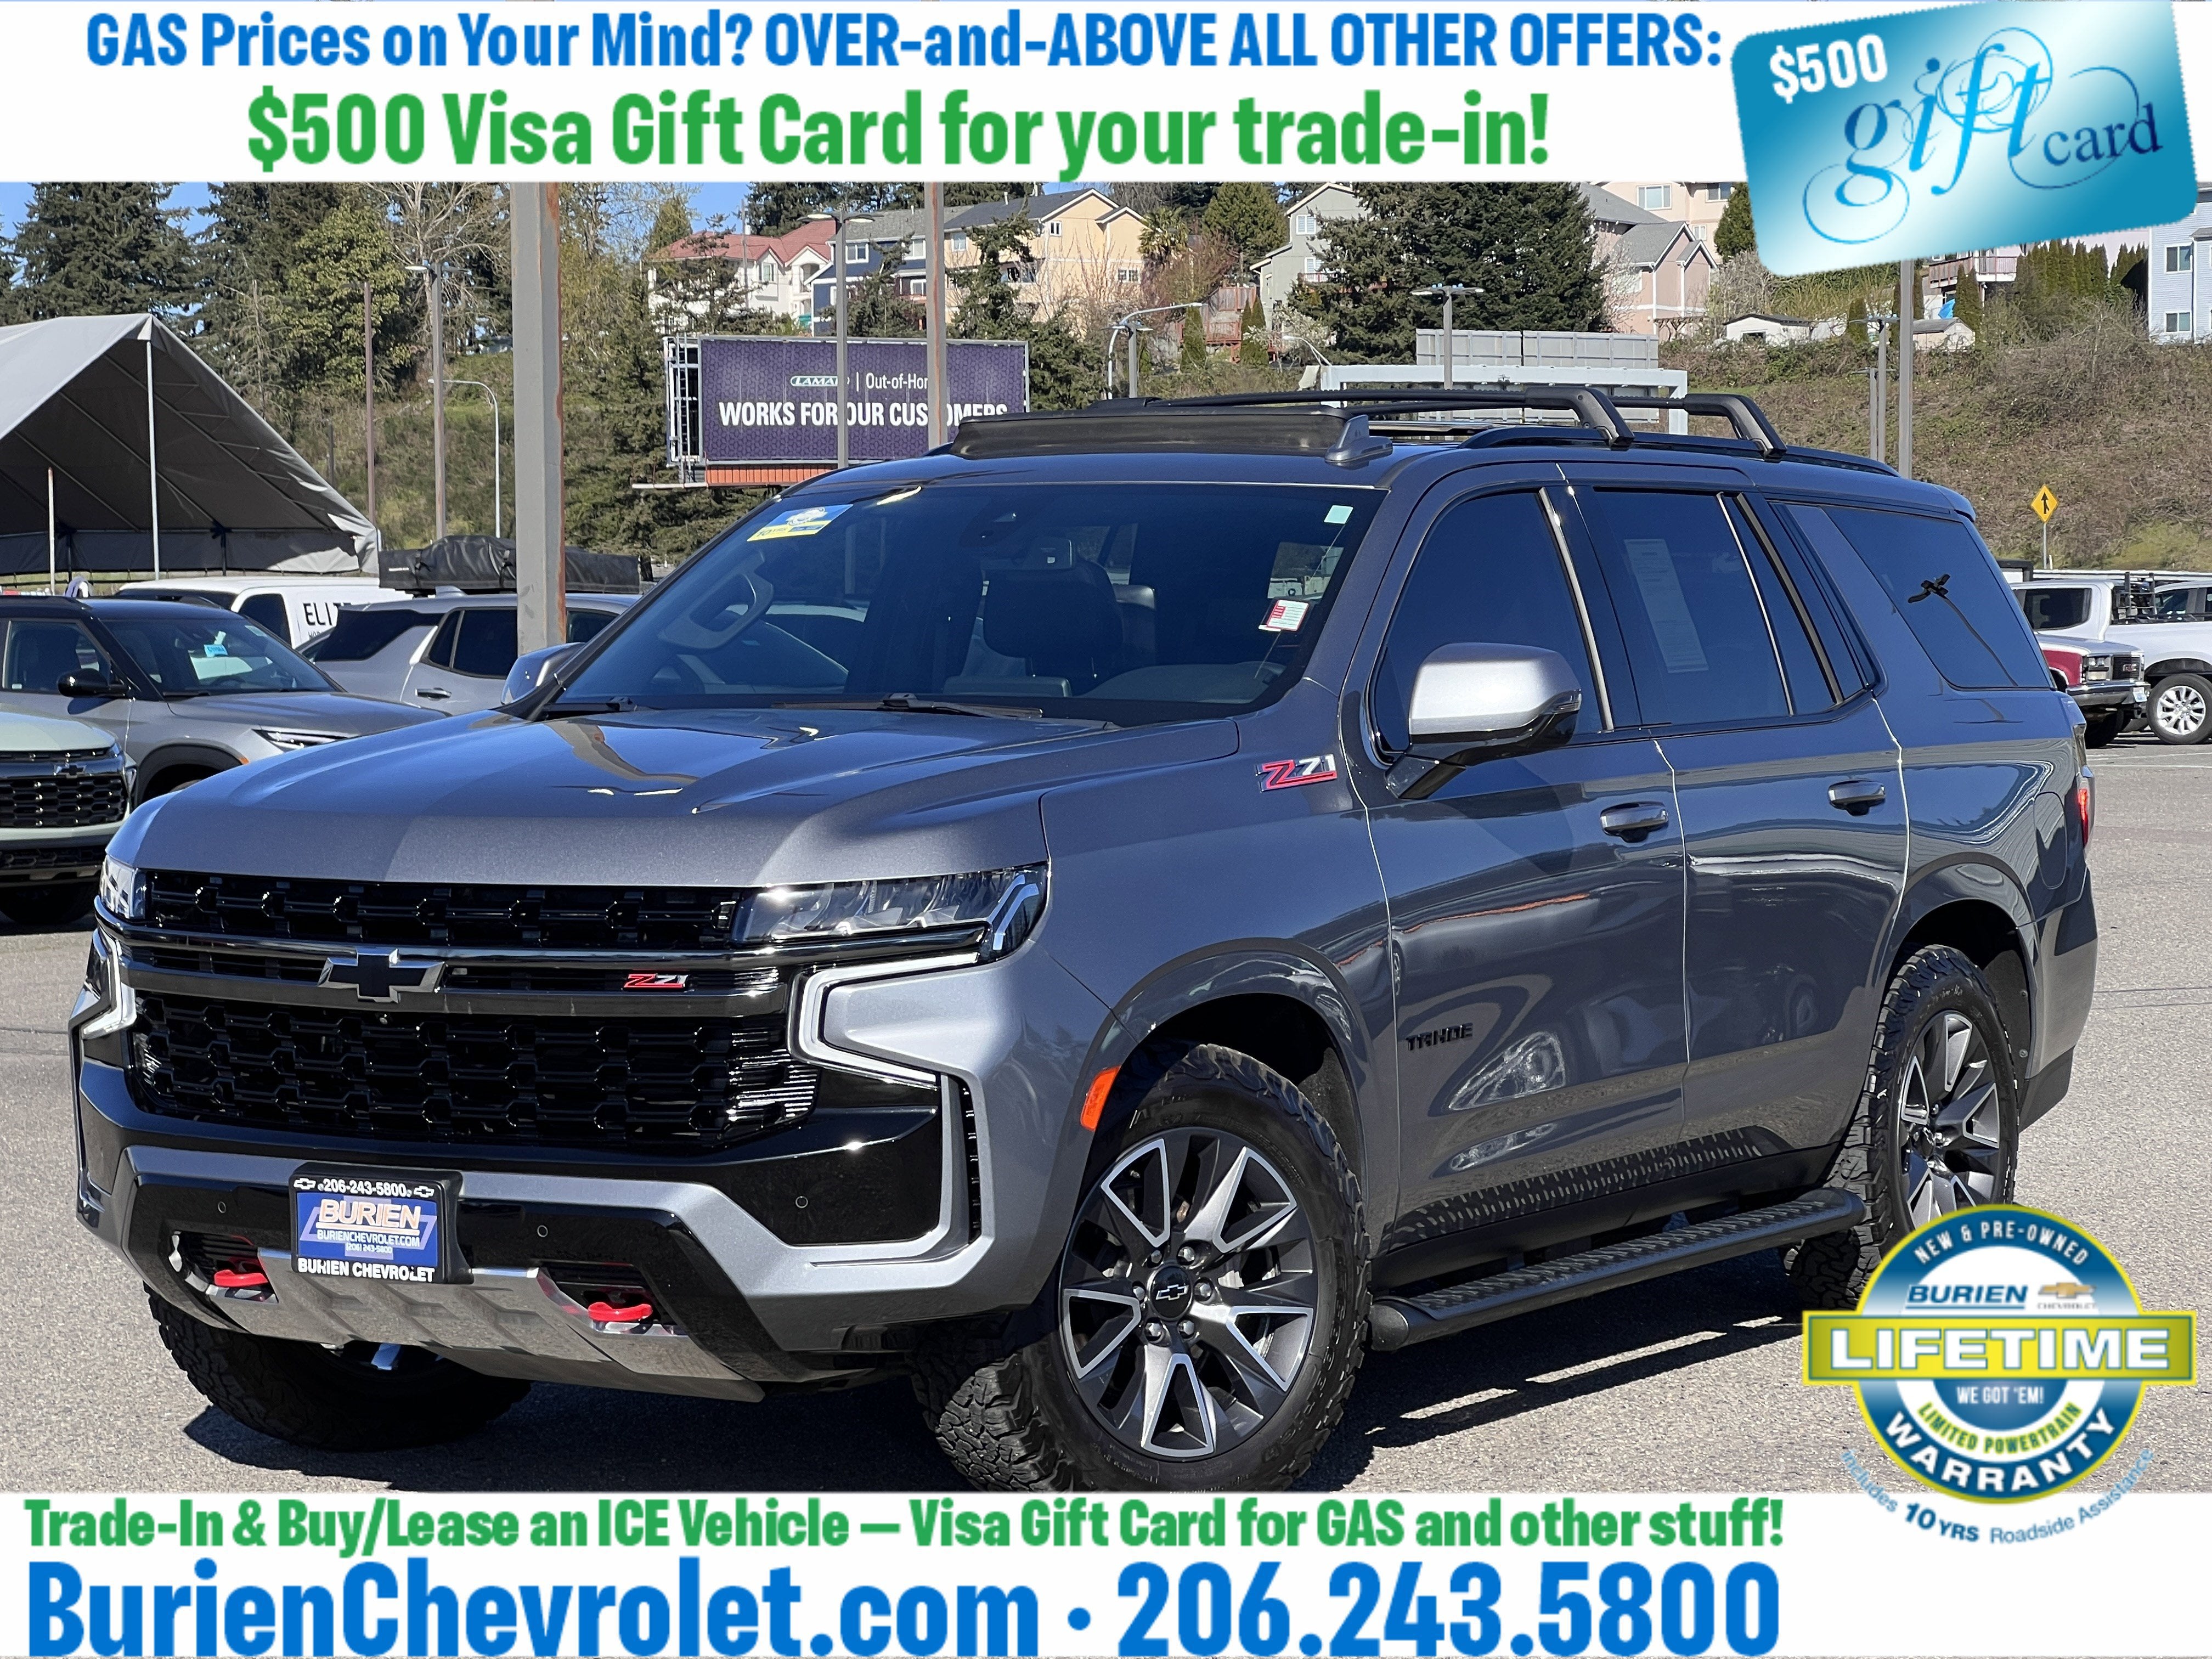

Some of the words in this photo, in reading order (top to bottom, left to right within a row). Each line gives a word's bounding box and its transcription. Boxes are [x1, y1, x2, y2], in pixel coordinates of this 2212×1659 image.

[866, 373, 928, 390] Out-of-Ho
[719, 402, 795, 426] WORKS
[800, 402, 838, 426] FOR
[303, 602, 352, 625] ELI
[1256, 754, 1338, 791] Z71
[624, 973, 688, 988] Z71
[323, 1178, 408, 1198] 206-243-5800
[319, 1199, 421, 1229] BURIEN
[317, 1229, 420, 1248] BURIENCHEVROLET.COM
[298, 1258, 349, 1276] BURIEN
[352, 1262, 436, 1283] CHEVROLET
